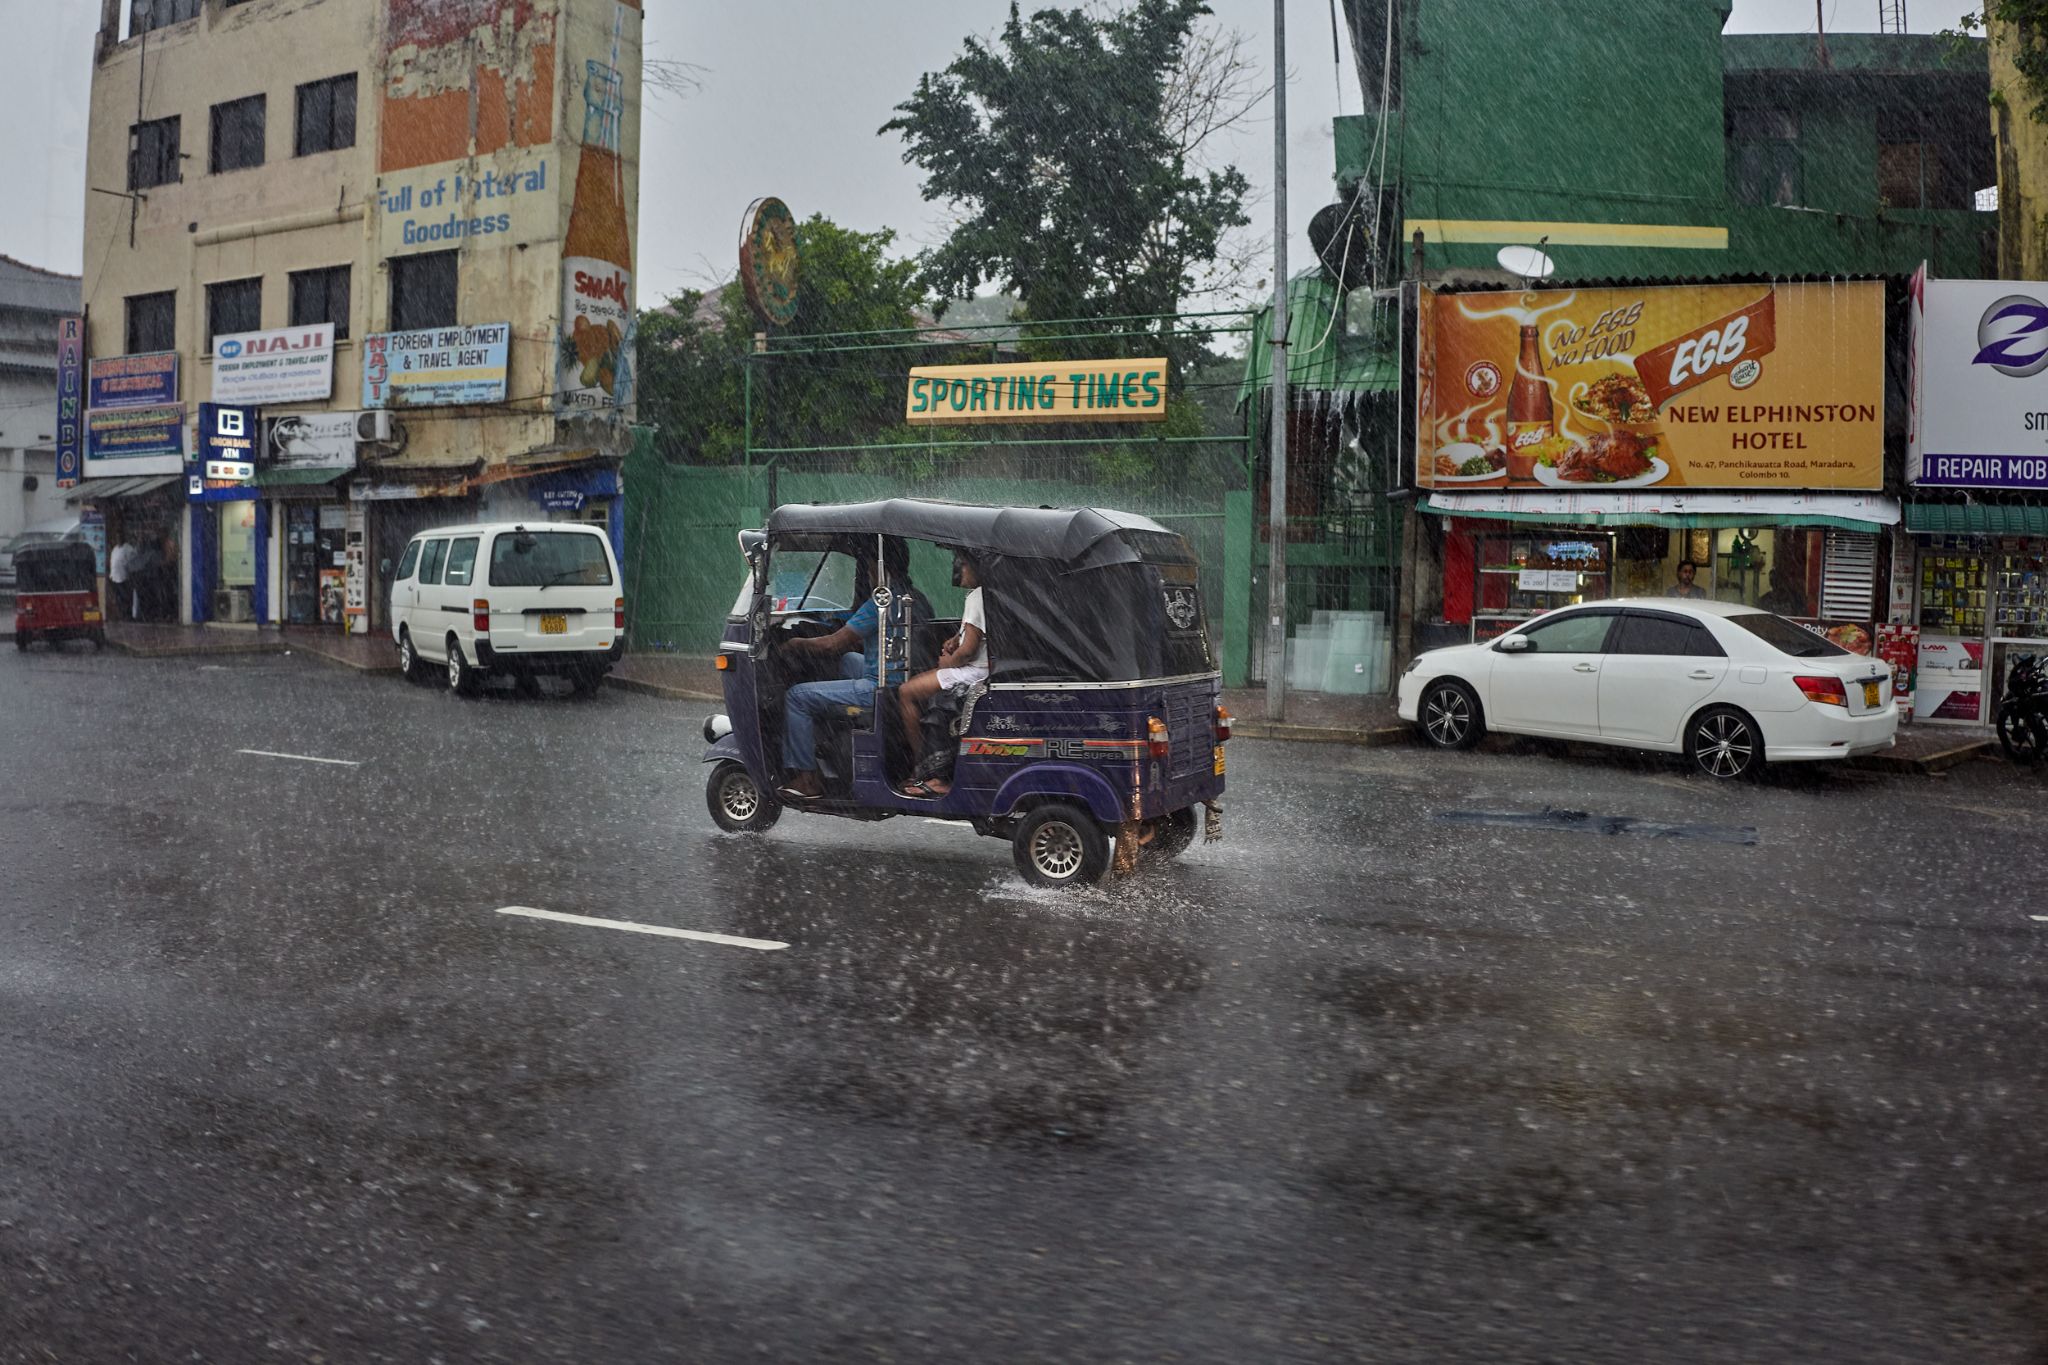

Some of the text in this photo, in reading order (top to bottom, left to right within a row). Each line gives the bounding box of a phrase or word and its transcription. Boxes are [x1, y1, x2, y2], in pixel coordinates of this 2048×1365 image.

[420, 179, 446, 208] of
[403, 213, 510, 244] Goodness
[1551, 300, 1645, 350] NO EGB
[246, 332, 323, 354] NAJI
[392, 327, 506, 351] FOREIGN EMPLOYMENT
[1547, 328, 1636, 370] NO FOOD
[403, 349, 489, 370] & TRAVEL AGENT
[1669, 315, 1750, 386] EGB
[368, 336, 388, 400] NAJI
[912, 371, 1160, 413] SPORTING TIMES
[1670, 404, 1875, 423] NEW ELPHINSTON
[209, 437, 252, 449] UNION BANK
[1515, 425, 1545, 446] EGB
[1732, 432, 1808, 449] HOTEL
[222, 449, 240, 459] ATM
[1689, 459, 1856, 470] No. 47, Panchikawatta Road, Maradana,
[1739, 471, 1790, 479] Colombo 10.
[1938, 458, 2002, 479] REPAIR
[2008, 459, 2047, 480] MOB
[1084, 751, 1123, 760] SUPER
